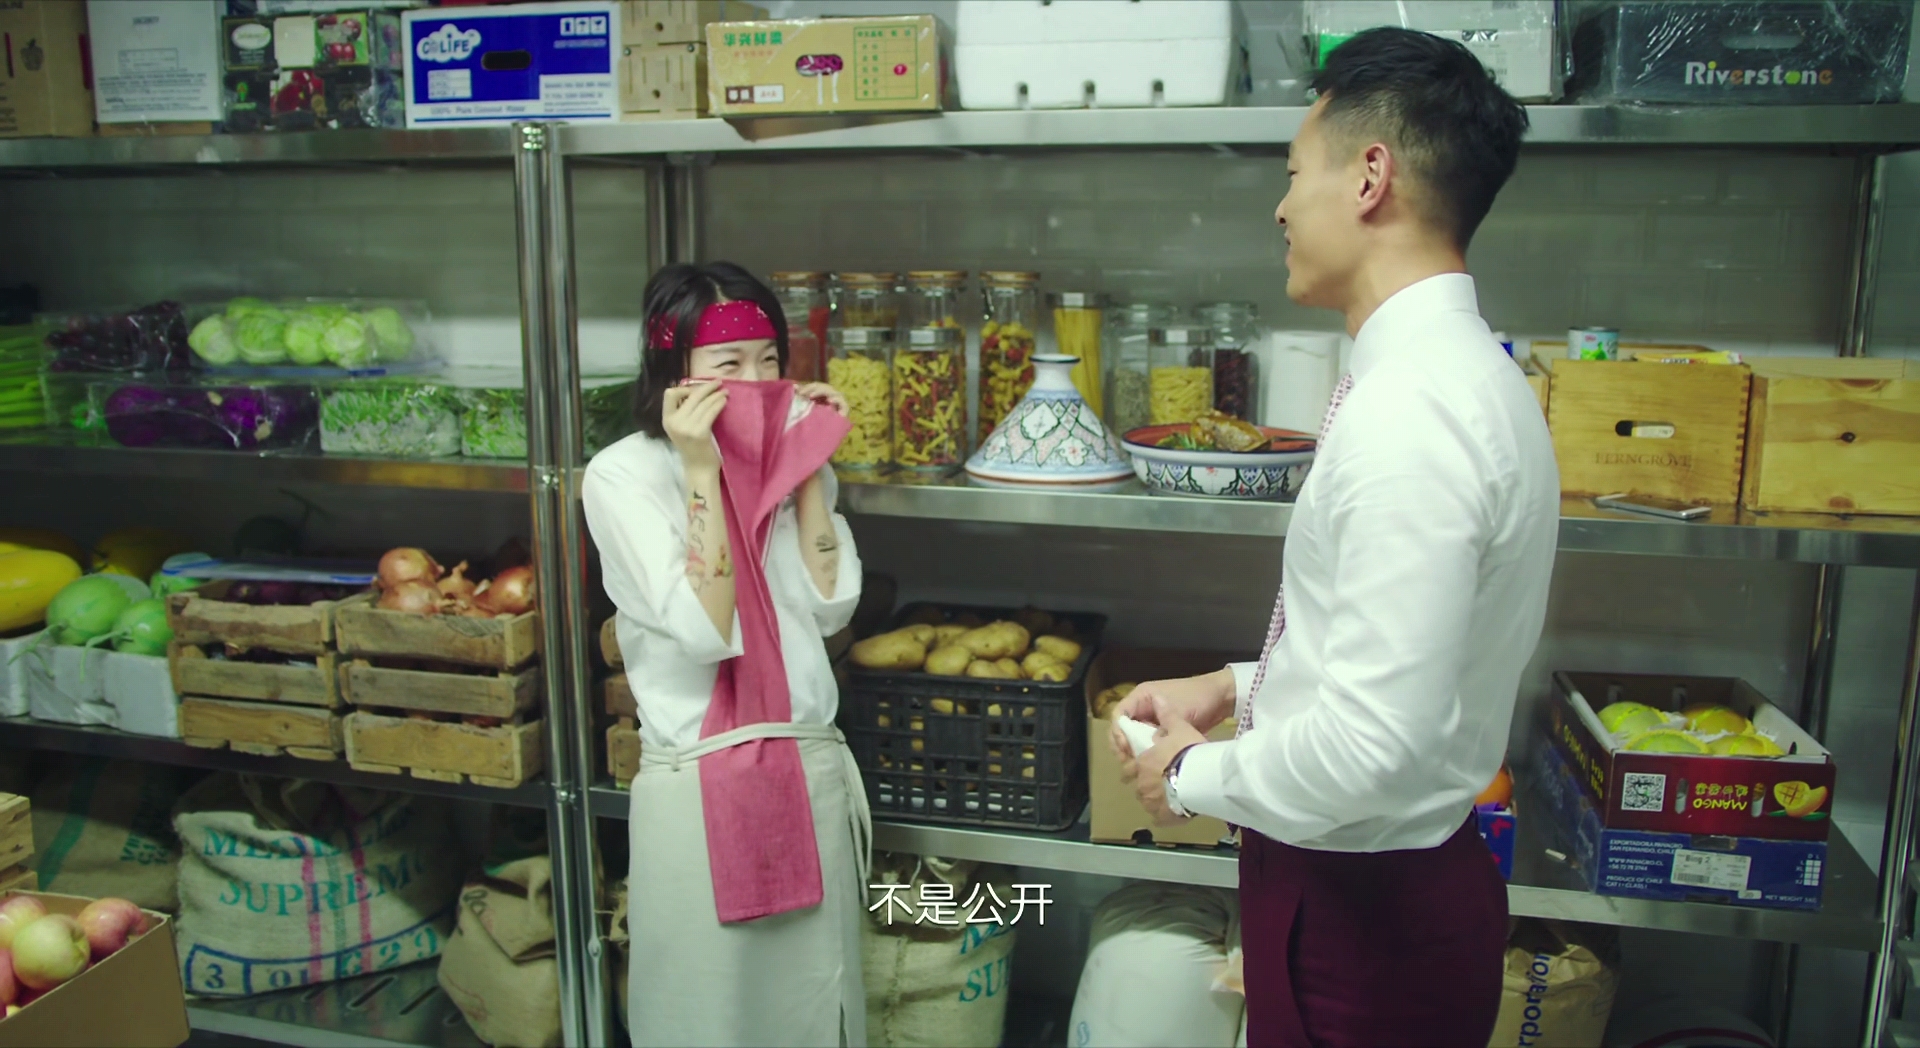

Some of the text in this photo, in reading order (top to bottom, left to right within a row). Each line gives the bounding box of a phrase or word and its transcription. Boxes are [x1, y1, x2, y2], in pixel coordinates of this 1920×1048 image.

[1684, 61, 1833, 85] Riverstone
[1693, 798, 1748, 811] MANGO
[204, 963, 226, 989] 3
